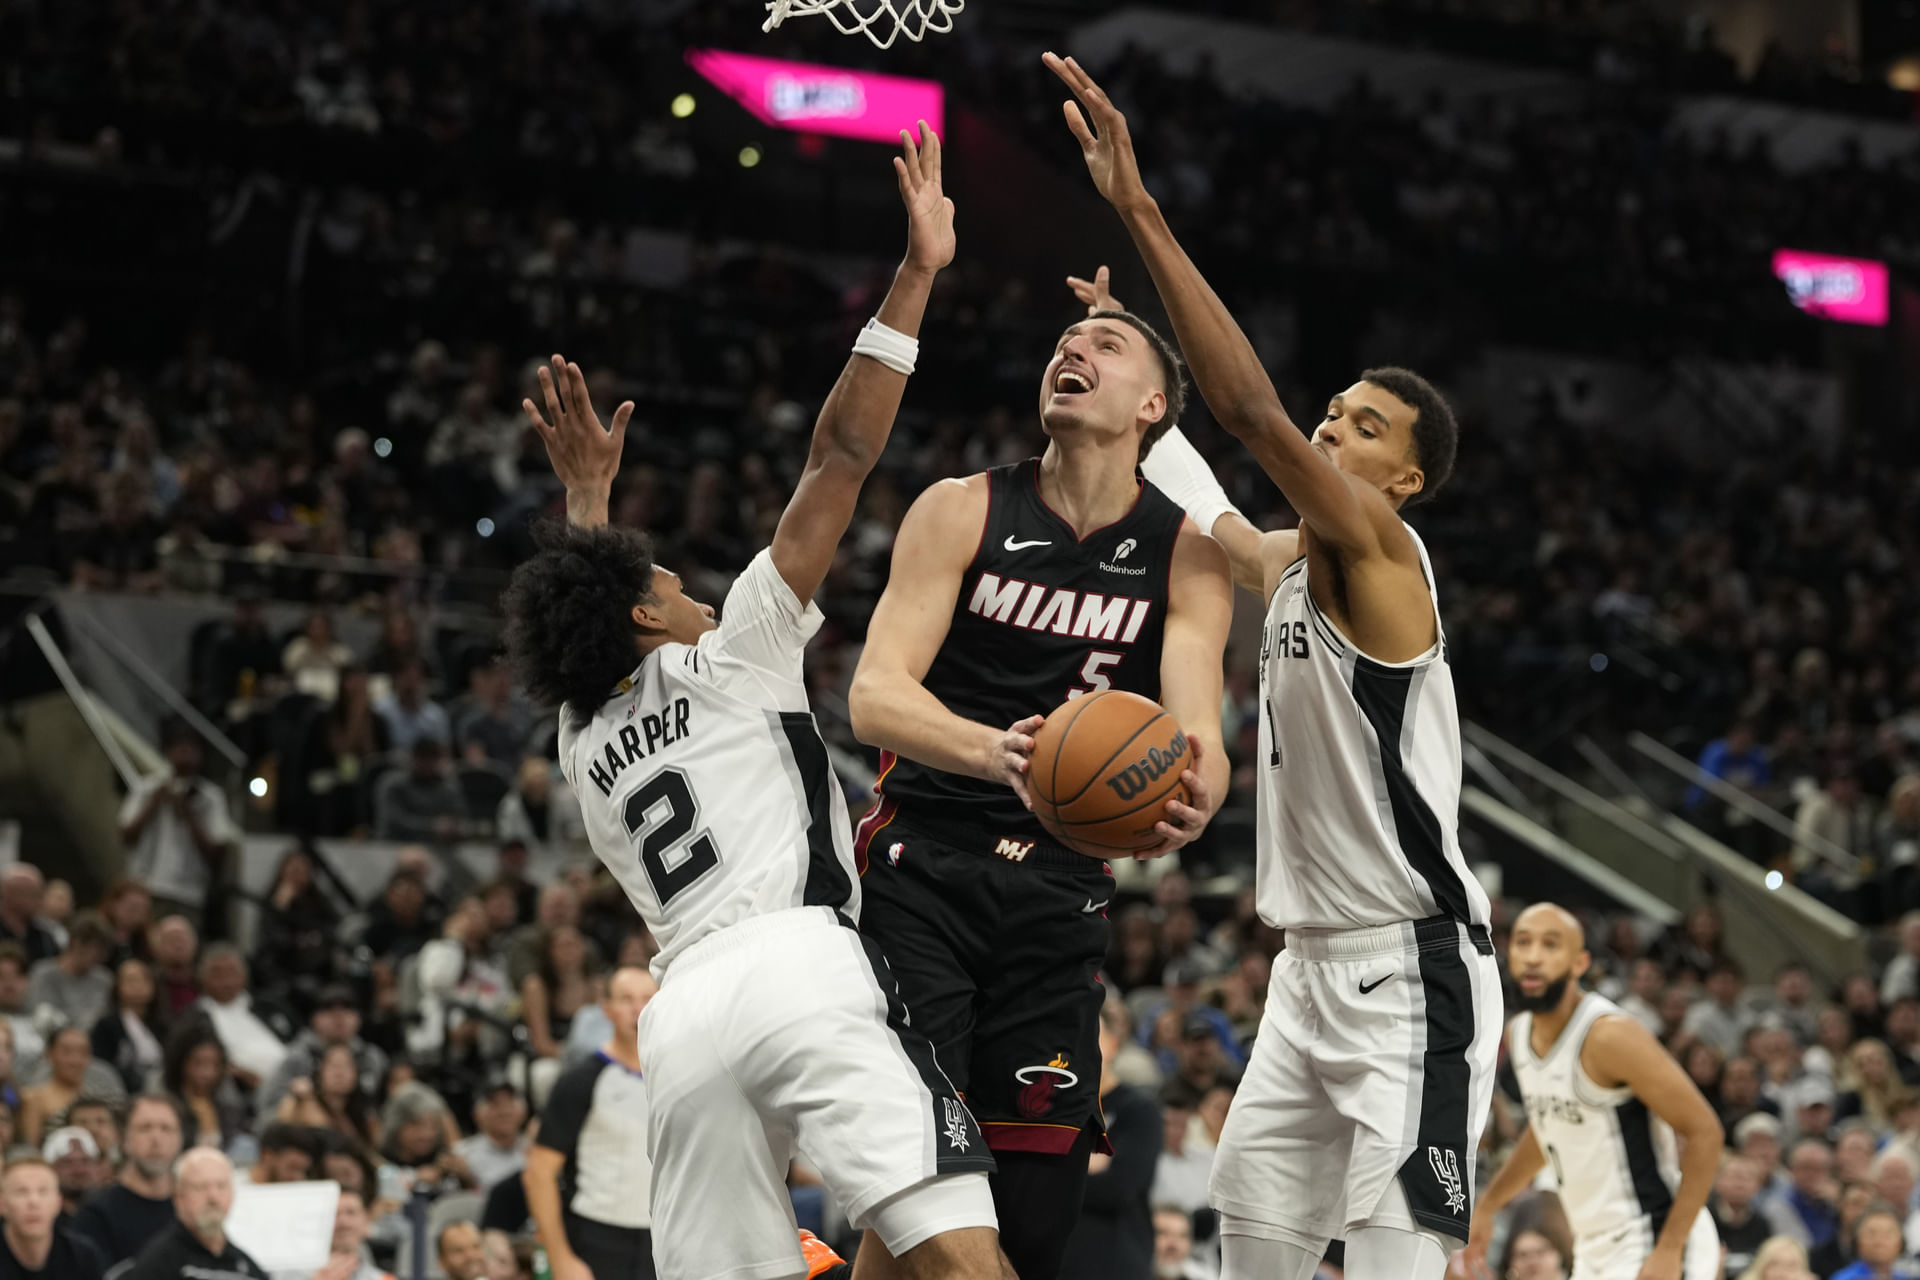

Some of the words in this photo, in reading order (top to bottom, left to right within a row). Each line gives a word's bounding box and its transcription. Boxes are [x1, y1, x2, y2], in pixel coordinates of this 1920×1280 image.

[1099, 561, 1146, 576] Robinhood
[968, 571, 1152, 644] MIAMI
[1261, 621, 1310, 662] URS
[1066, 648, 1127, 702] 5
[588, 697, 690, 798] HARPER
[1106, 730, 1189, 802] Wilson
[621, 764, 724, 915] 2
